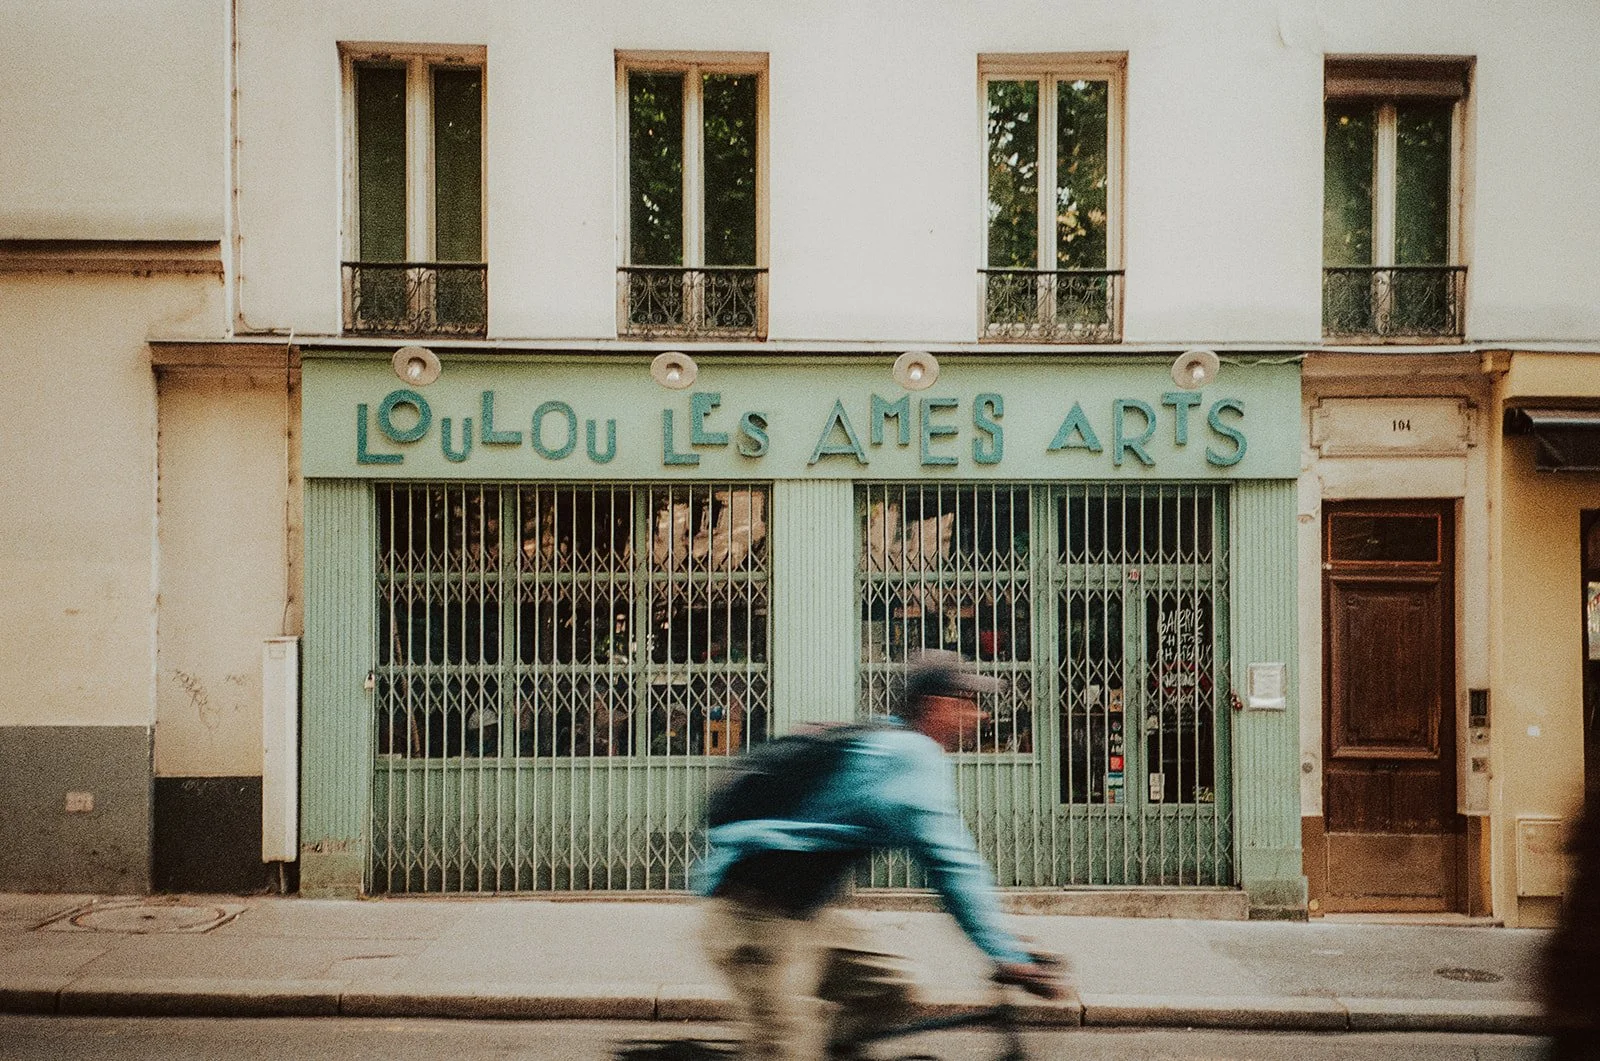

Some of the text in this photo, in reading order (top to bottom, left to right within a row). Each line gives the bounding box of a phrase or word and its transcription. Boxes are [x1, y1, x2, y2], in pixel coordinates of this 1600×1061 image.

[356, 389, 1248, 466] LOULOU LES AMES ARTS
[1392, 419, 1411, 431] 104
